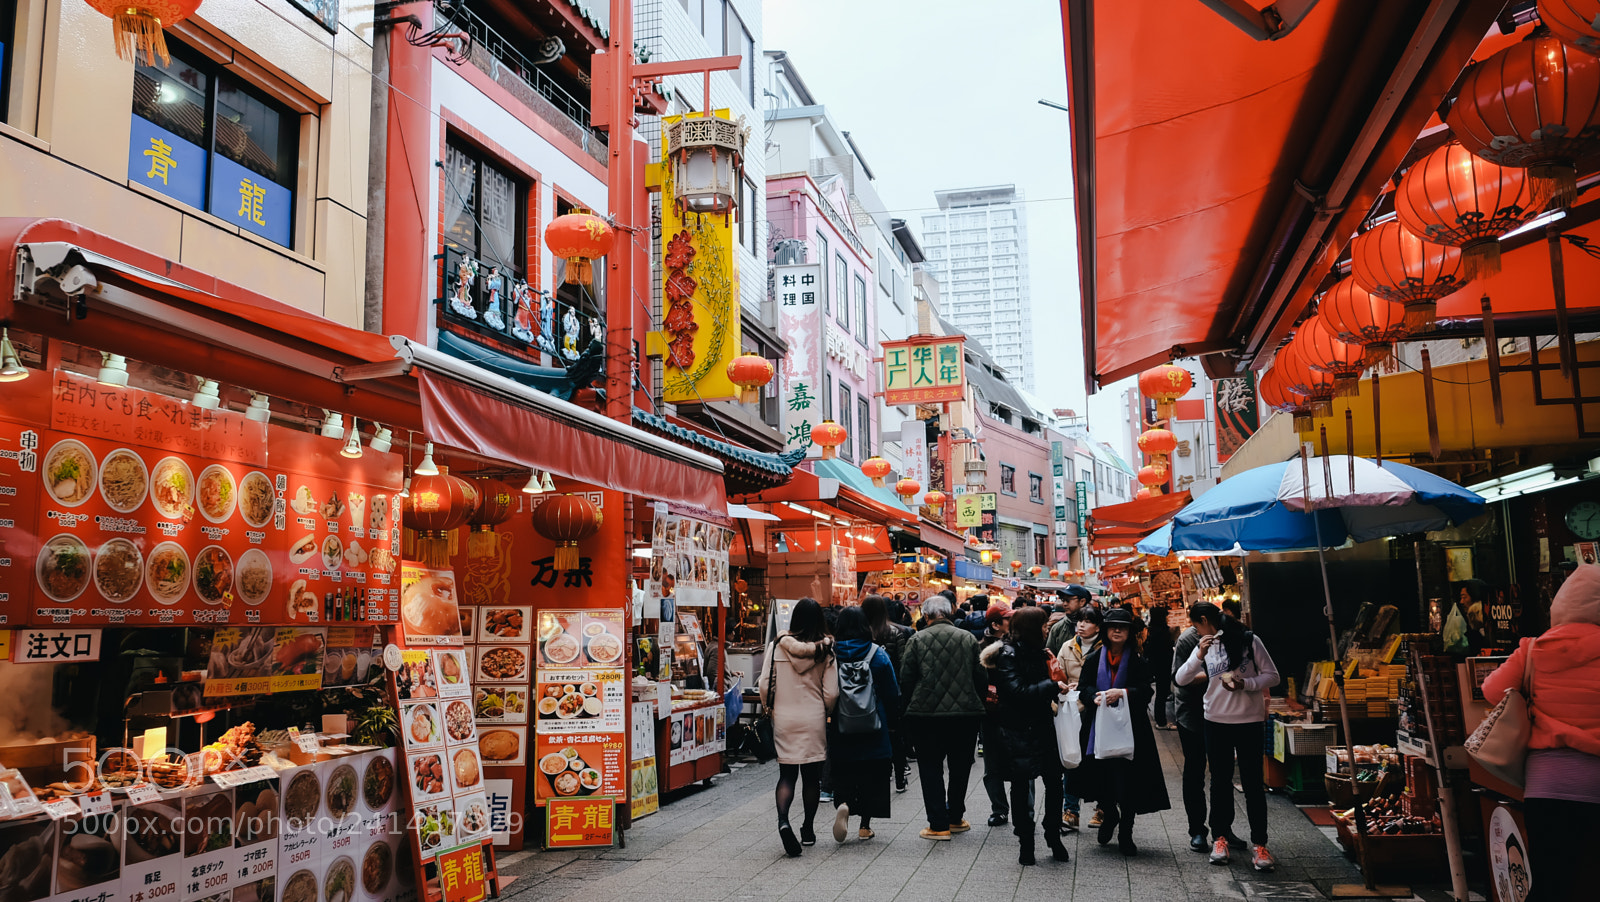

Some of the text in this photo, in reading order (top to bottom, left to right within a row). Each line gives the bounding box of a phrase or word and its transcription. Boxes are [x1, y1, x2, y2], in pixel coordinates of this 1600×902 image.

[143, 137, 266, 227] 青 龍
[782, 274, 797, 306] 料理
[801, 273, 815, 305] 中国
[887, 349, 907, 387] 工厂
[912, 347, 933, 385] 华人
[938, 345, 959, 384] 青年
[21, 431, 37, 472] 串物
[1491, 604, 1512, 620] COKO
[26, 632, 92, 659] 注文口
[549, 673, 621, 682] おすすめセット 1,280円
[550, 803, 612, 831] 青龍
[243, 847, 268, 863] ゴマ団子
[332, 836, 351, 850] 350円
[191, 860, 224, 878] 北京ダック
[252, 859, 274, 875] 200円
[290, 850, 311, 864] 350円
[144, 870, 161, 885] 豚足
[187, 872, 228, 895] 1枚 500円
[442, 851, 484, 892] 青龍
[148, 882, 176, 900] 300円
